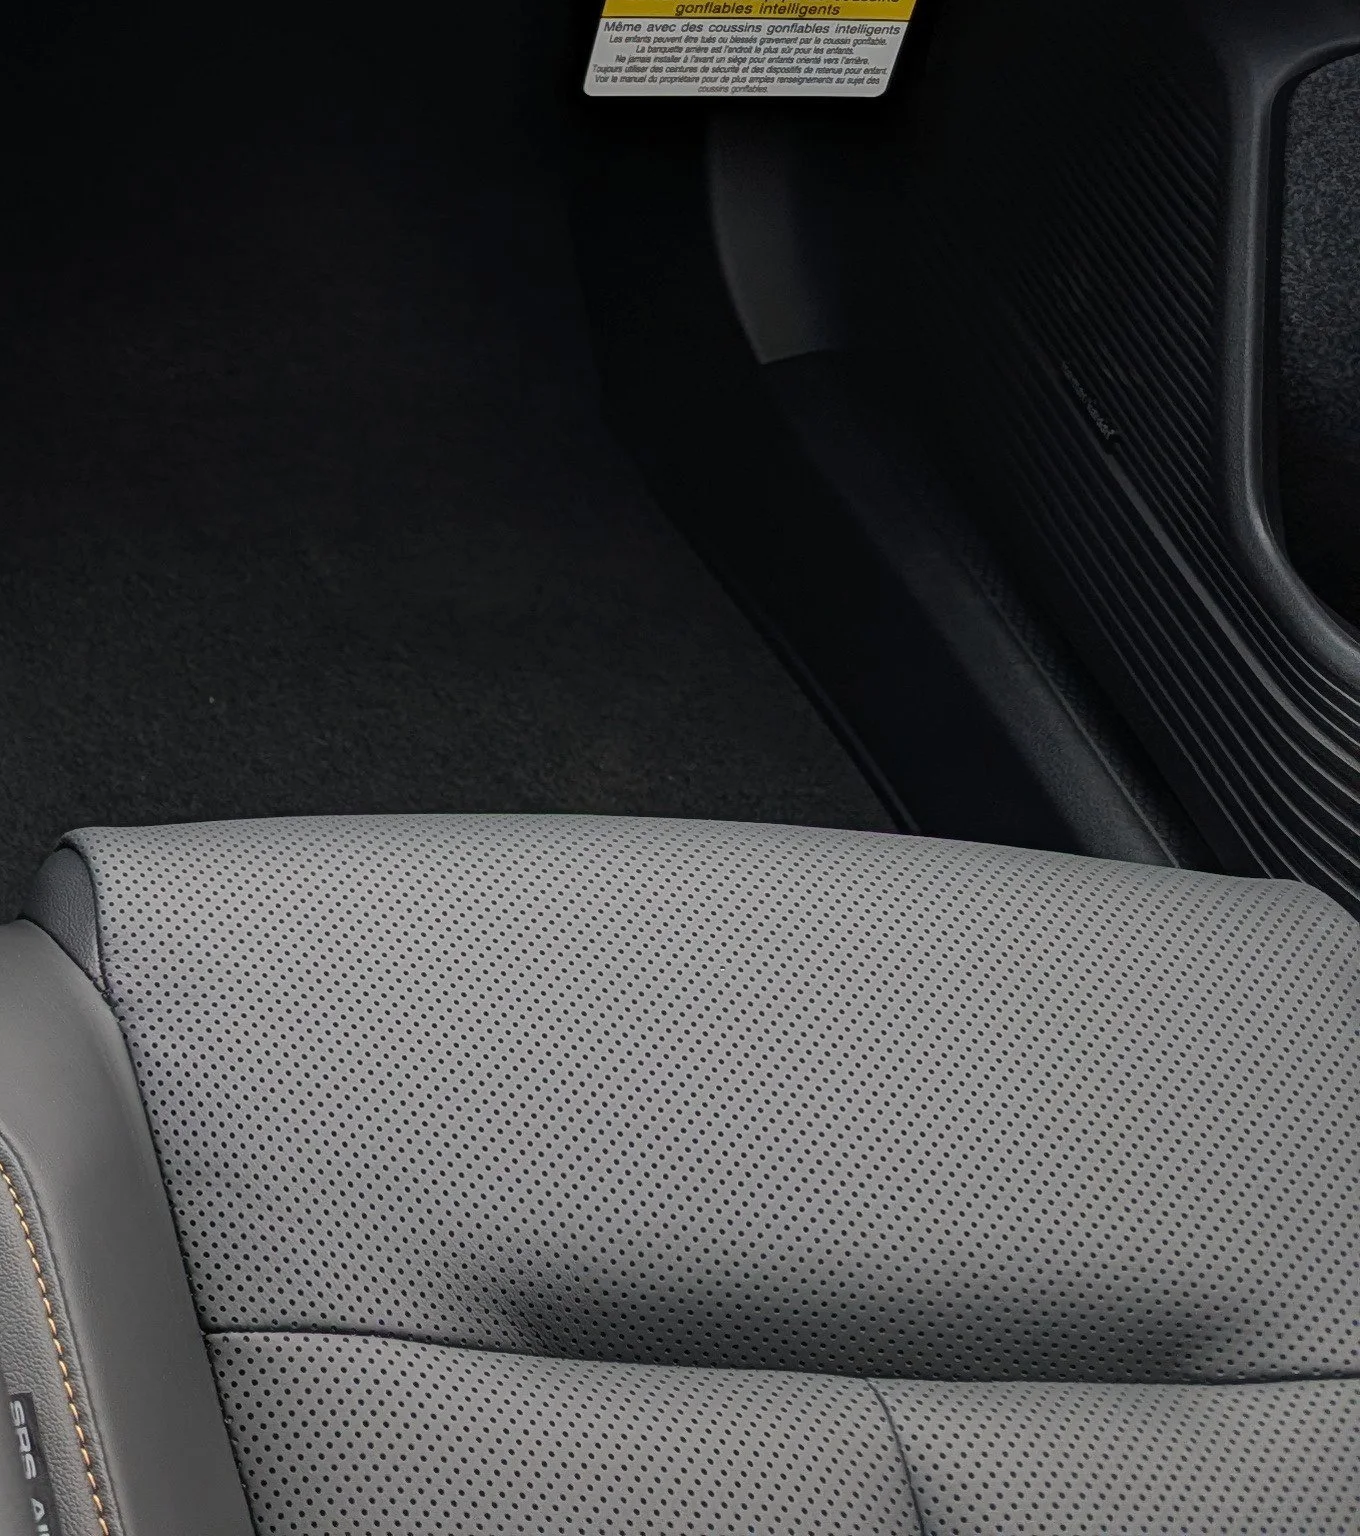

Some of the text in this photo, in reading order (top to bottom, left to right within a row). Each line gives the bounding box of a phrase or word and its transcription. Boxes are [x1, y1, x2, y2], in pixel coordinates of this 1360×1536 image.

[673, 0, 843, 18] gonflables intelligents
[602, 19, 902, 37] Même avec des coussins gonflables intelligents
